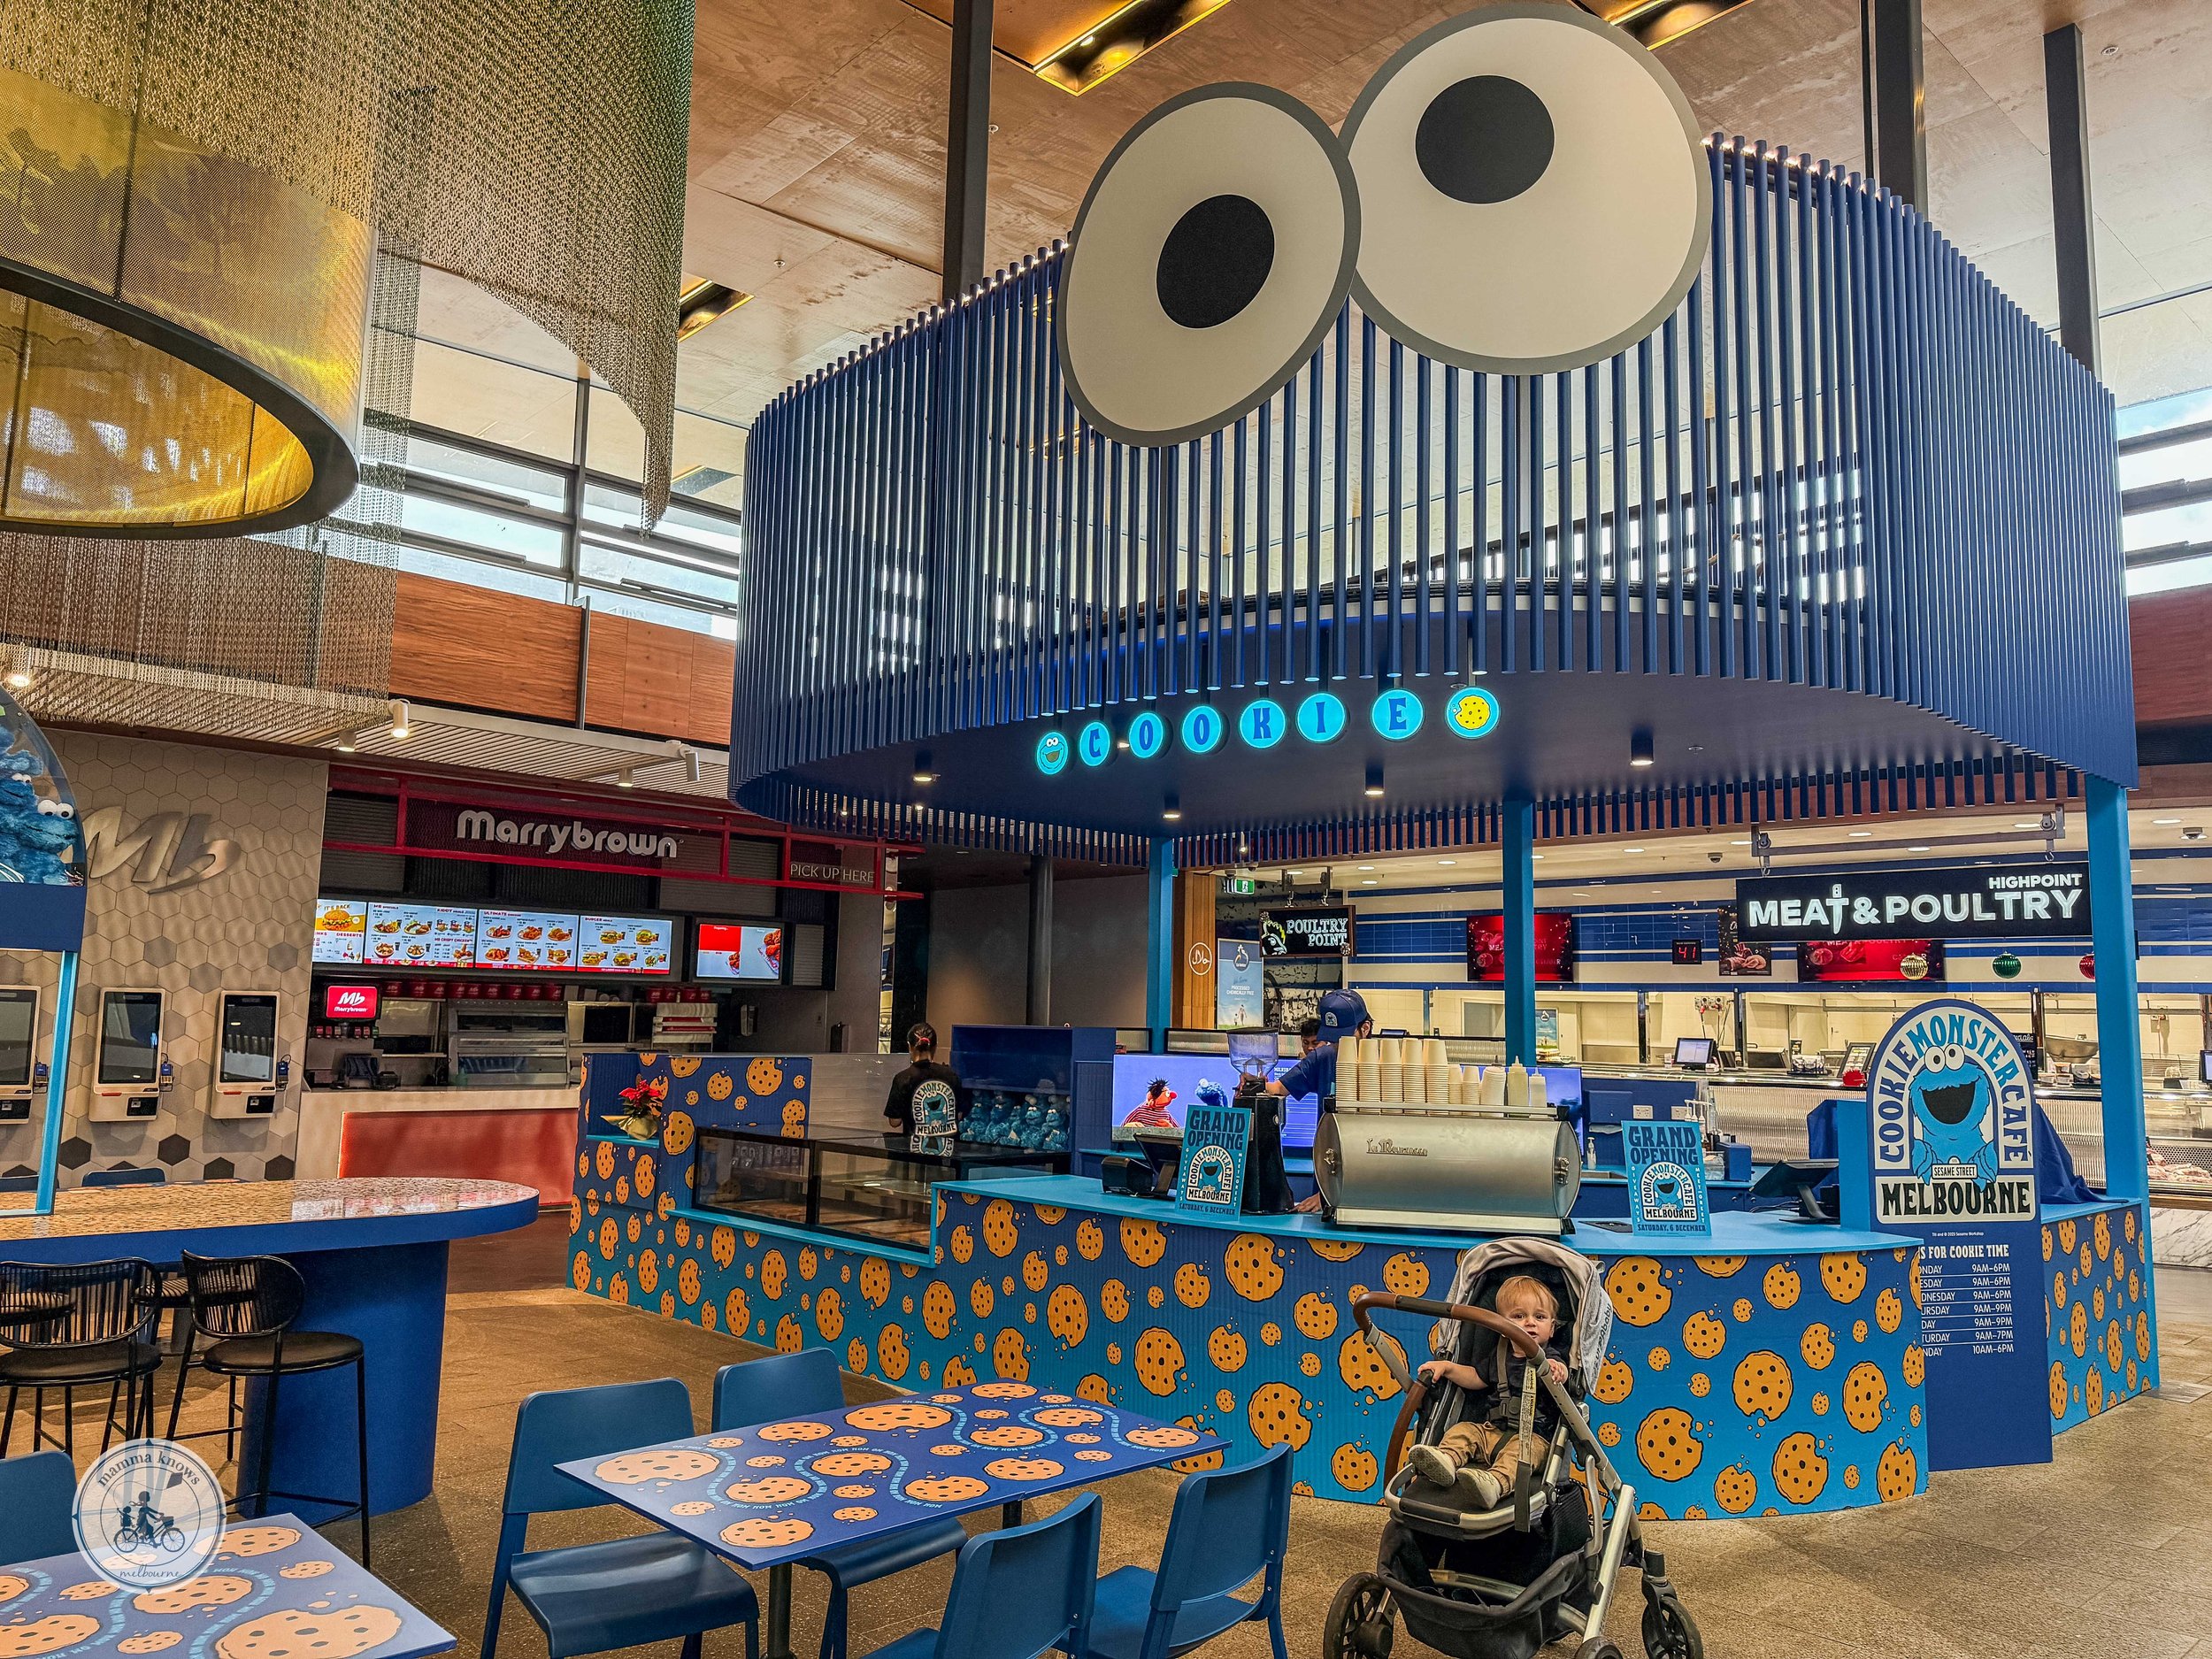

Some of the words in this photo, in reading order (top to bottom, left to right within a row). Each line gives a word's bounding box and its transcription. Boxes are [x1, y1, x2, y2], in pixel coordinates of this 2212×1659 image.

[1087, 697, 1409, 758] COOKIE
[790, 864, 818, 878] PICK
[822, 867, 840, 879] UP
[843, 868, 875, 883] HERE
[1988, 873, 2083, 889] HIGHPOINT
[1748, 883, 1850, 935] MEAT
[1853, 896, 1881, 925] &
[1886, 888, 2083, 924] POULTRY
[1286, 918, 1348, 934] POULTRY
[1308, 933, 1348, 947] POINT
[1678, 947, 1696, 959] 41
[337, 992, 365, 1006] Mb
[1878, 1040, 1919, 1164] COOKIE
[1906, 1013, 2020, 1088] MONSTER
[917, 1123, 956, 1134] MELBOURNE
[1189, 1110, 1246, 1133] GRAND
[1187, 1130, 1243, 1150] OPENING
[1628, 1125, 1697, 1148] GRAND
[1630, 1148, 1699, 1165] OPENING
[1189, 1154, 1204, 1185] COOKIE
[1202, 1148, 1232, 1167] MONSTER
[1933, 1166, 1955, 1177] SESAME
[1955, 1166, 1975, 1176] STREET
[1179, 1148, 1190, 1202] GIVEAWAYS
[1643, 1171, 1655, 1204] COOKIE
[1652, 1164, 1689, 1184] MONSTER
[1187, 1188, 1230, 1202] MELBOURNE
[1631, 1166, 1640, 1223] GIVEAWAYS
[1880, 1180, 2032, 1217] MELBOURNE
[1210, 1206, 1236, 1215] DECEMBER
[1646, 1209, 1695, 1218] MELBOURNE
[1928, 1246, 1947, 1259] FOR
[1949, 1245, 1985, 1258] COOKIE
[1985, 1244, 2009, 1257] TIME
[1918, 1265, 1943, 1274] ONDAY
[1920, 1279, 1943, 1288] ESDAY
[1921, 1292, 1956, 1302] DNESDAY
[1921, 1306, 1950, 1316] URSDAY
[1921, 1320, 1936, 1330] DAY
[1922, 1333, 1951, 1343] TURDAY
[1923, 1348, 1943, 1357] NDAY
